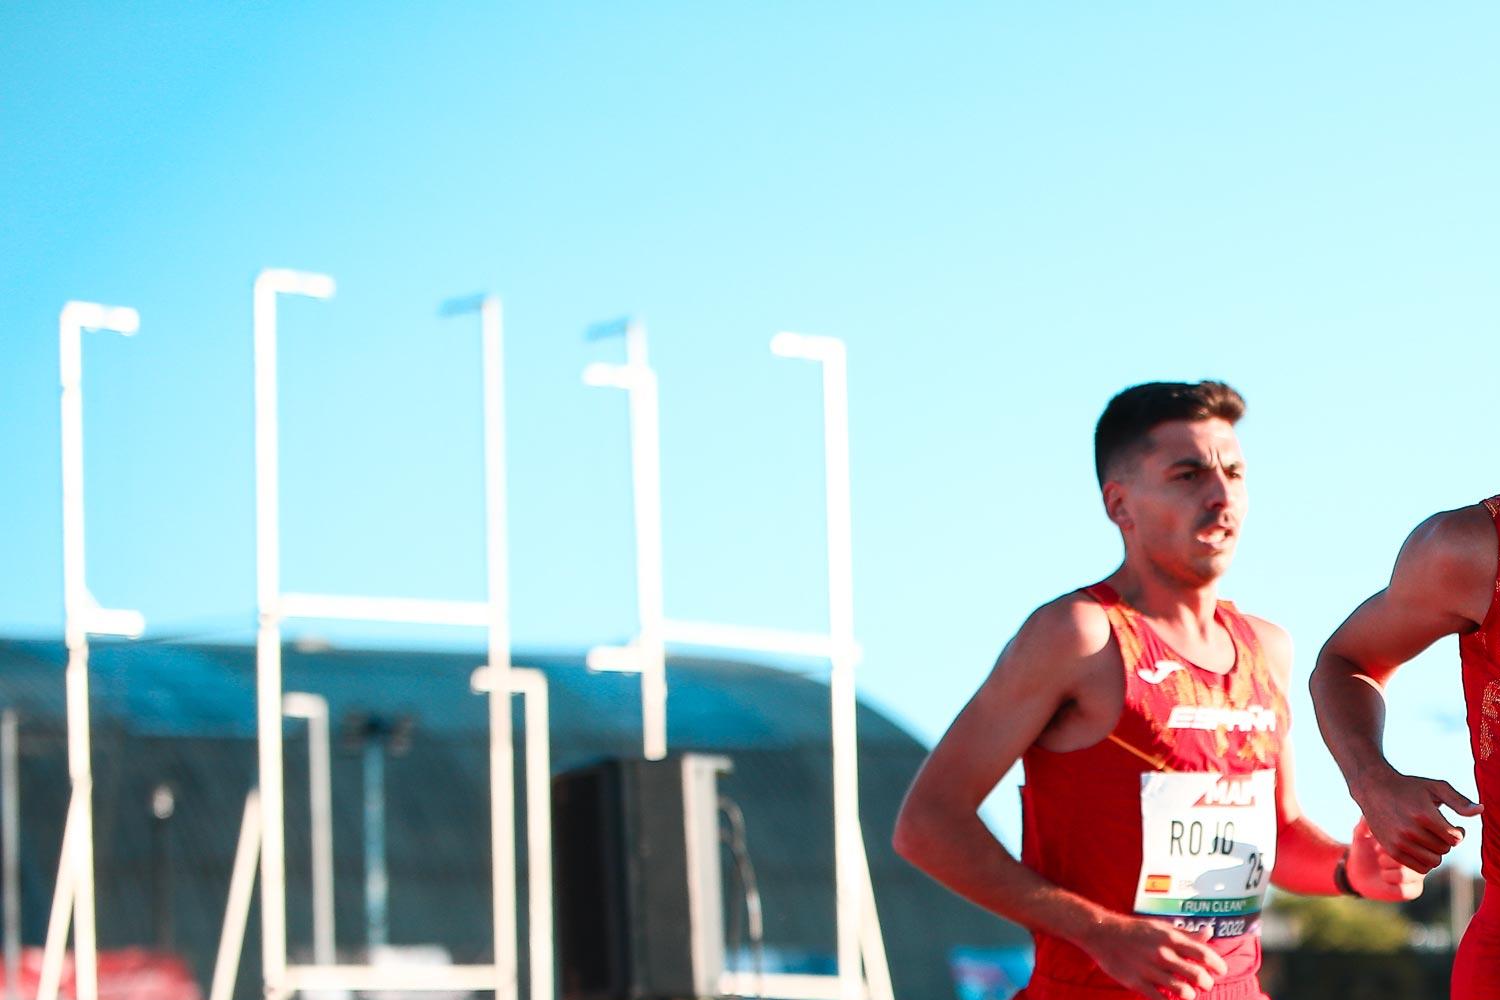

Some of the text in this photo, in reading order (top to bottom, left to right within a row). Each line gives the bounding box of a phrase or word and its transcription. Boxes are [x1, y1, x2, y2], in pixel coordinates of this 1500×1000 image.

[1169, 820, 1235, 856] ROJO
[1245, 852, 1264, 890] 25
[1185, 900, 1210, 913] RUN
[1217, 919, 1247, 937] 2022
